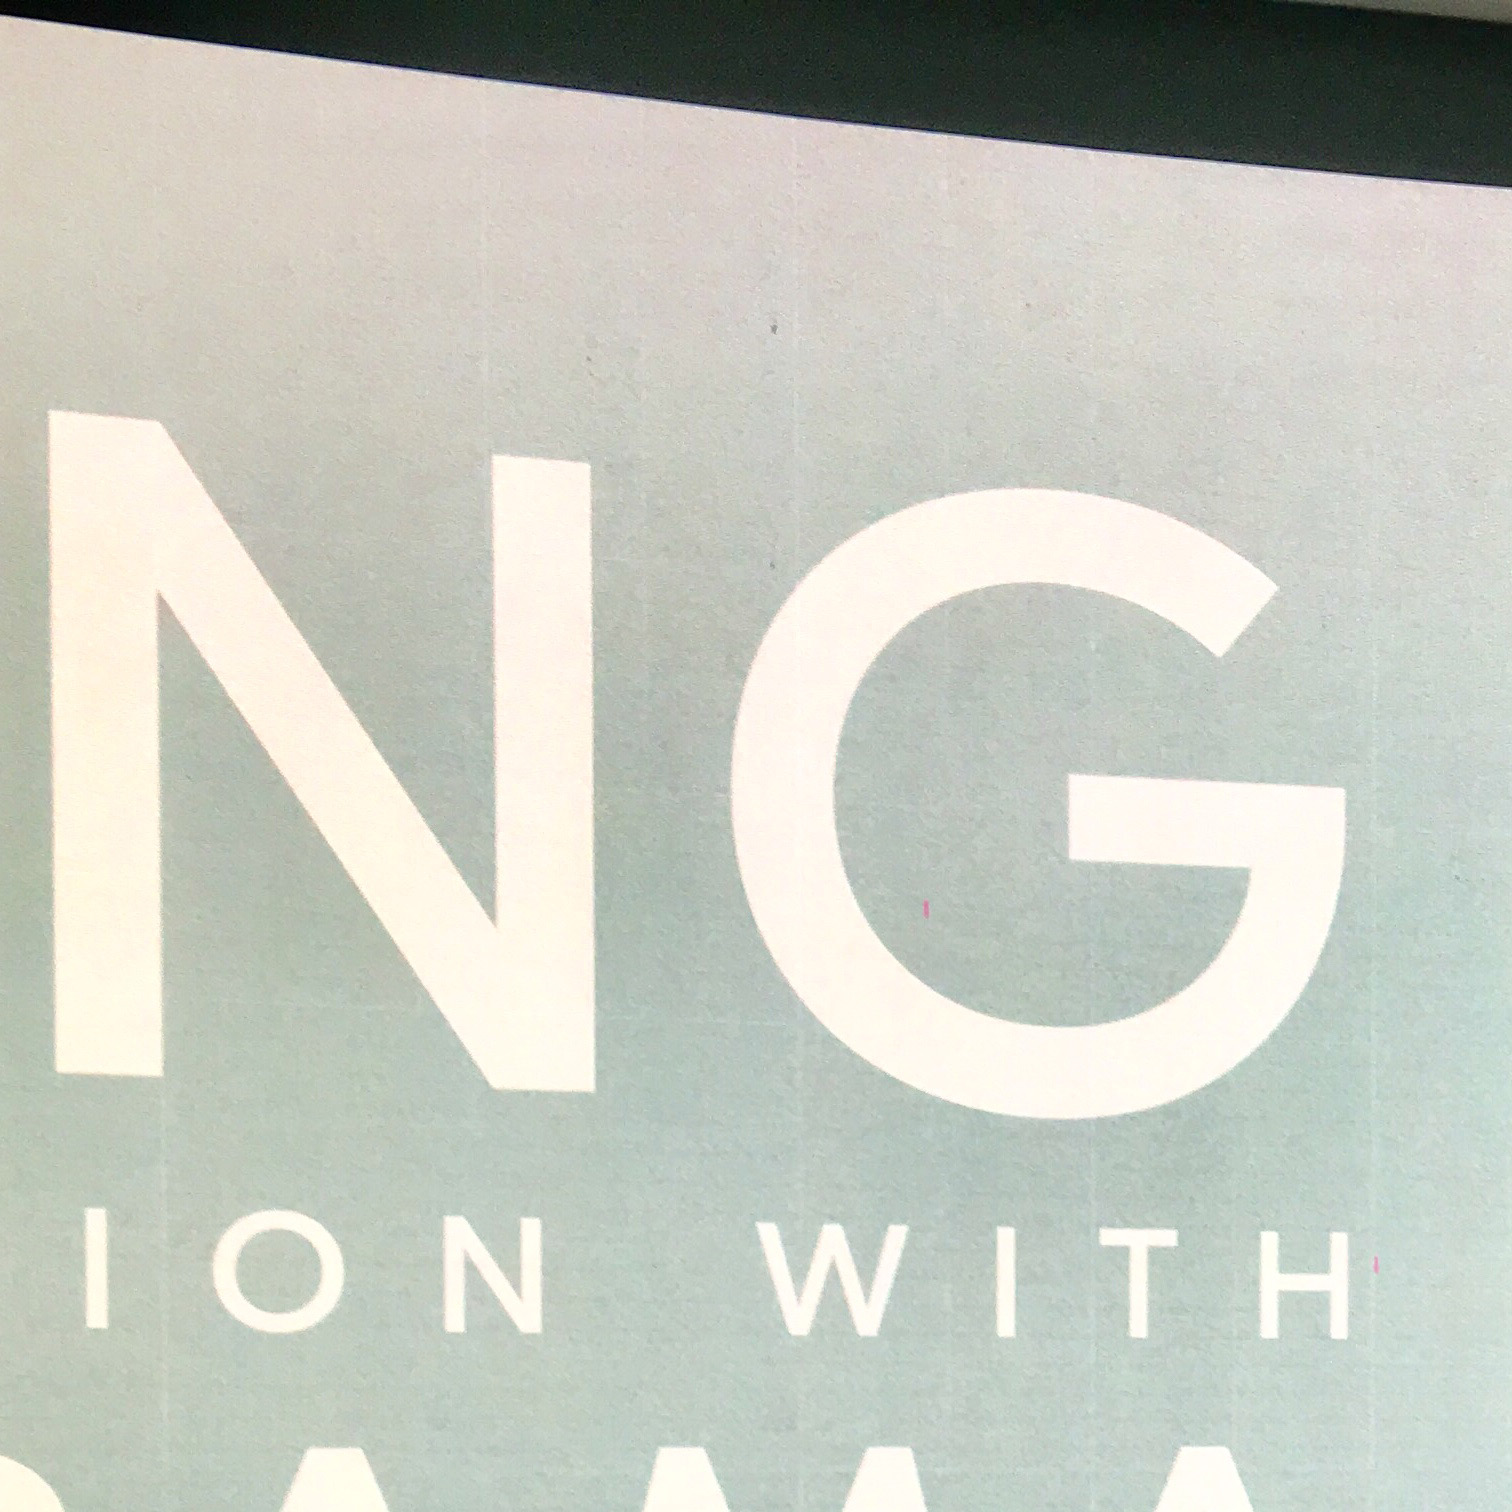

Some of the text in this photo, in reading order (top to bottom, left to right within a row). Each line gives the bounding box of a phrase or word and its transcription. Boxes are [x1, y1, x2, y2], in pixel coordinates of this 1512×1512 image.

[48, 408, 1347, 1120] NG
[84, 1207, 1350, 1339] ION WITH
